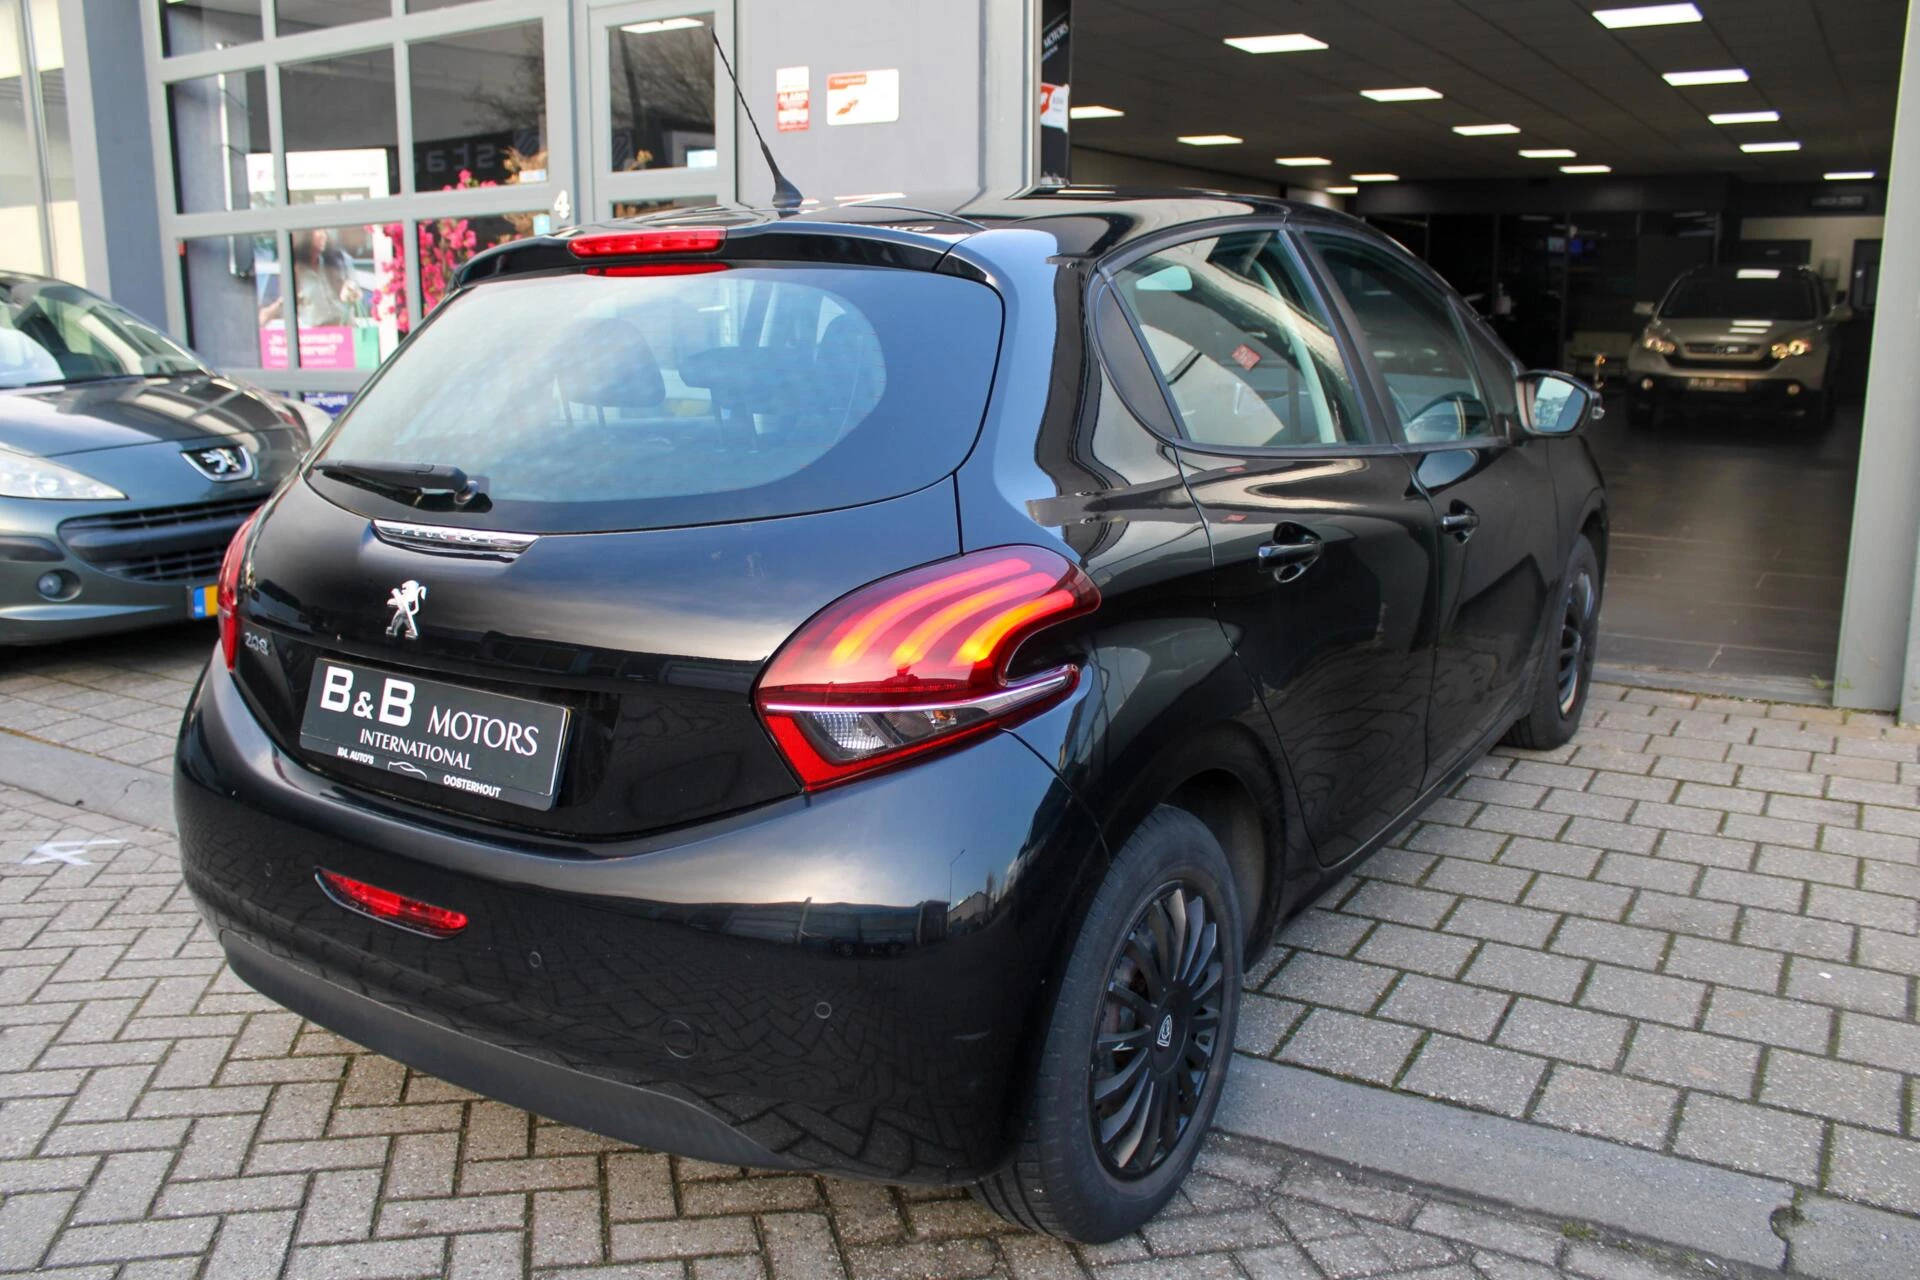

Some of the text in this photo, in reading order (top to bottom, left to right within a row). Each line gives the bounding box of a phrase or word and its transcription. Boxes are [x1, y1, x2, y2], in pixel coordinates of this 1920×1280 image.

[553, 190, 570, 219] 4
[244, 631, 269, 656] 208
[427, 705, 539, 756] MOTORS
[349, 750, 374, 765] AUTO'S
[360, 728, 472, 771] INTERNATIONAL
[443, 774, 501, 798] OOSTERHOUT
